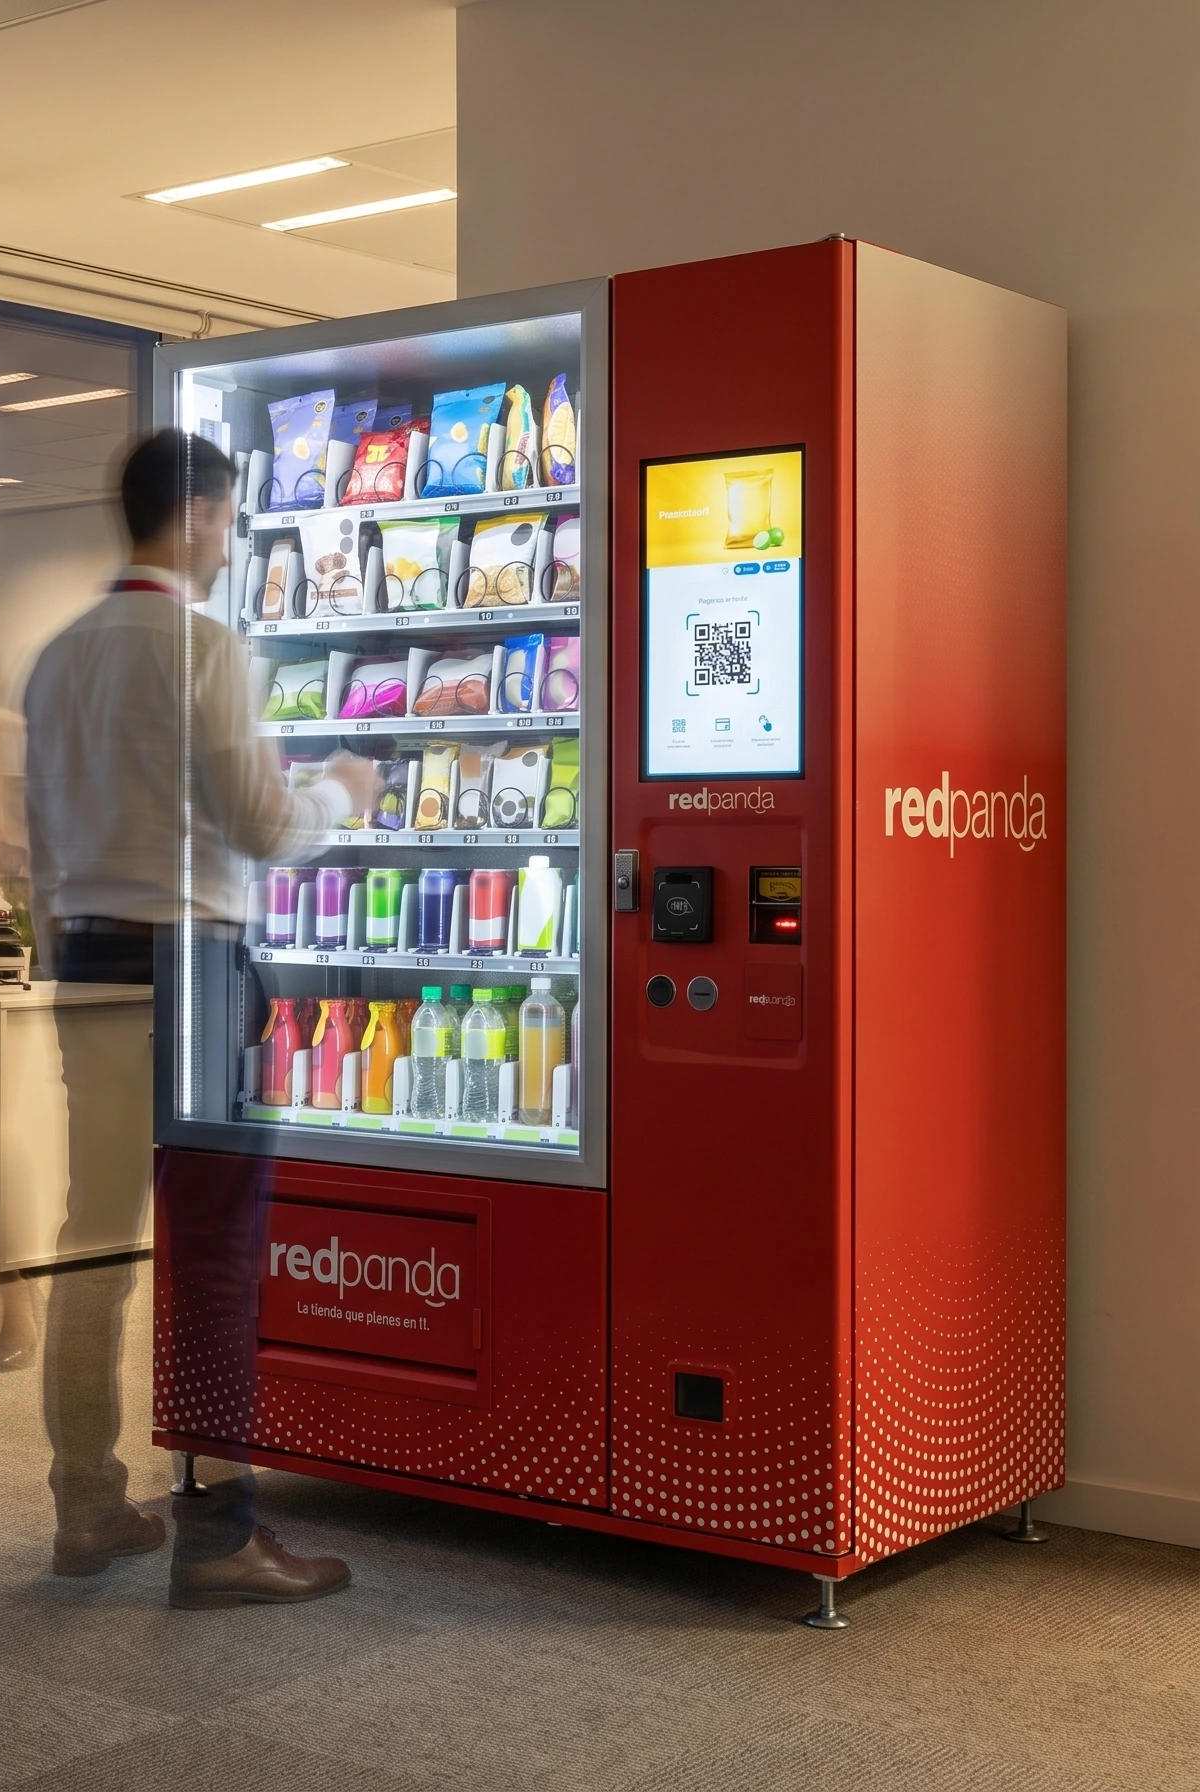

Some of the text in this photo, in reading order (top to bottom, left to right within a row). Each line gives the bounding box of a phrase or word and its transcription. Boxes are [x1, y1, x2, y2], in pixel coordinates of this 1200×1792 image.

[669, 786, 775, 816] redpanda
[885, 770, 1047, 859] redpanda
[270, 1236, 460, 1308] redpanda
[297, 1301, 309, 1314] La
[311, 1303, 342, 1319] tienda
[345, 1310, 364, 1323] que
[403, 1318, 417, 1329] en
